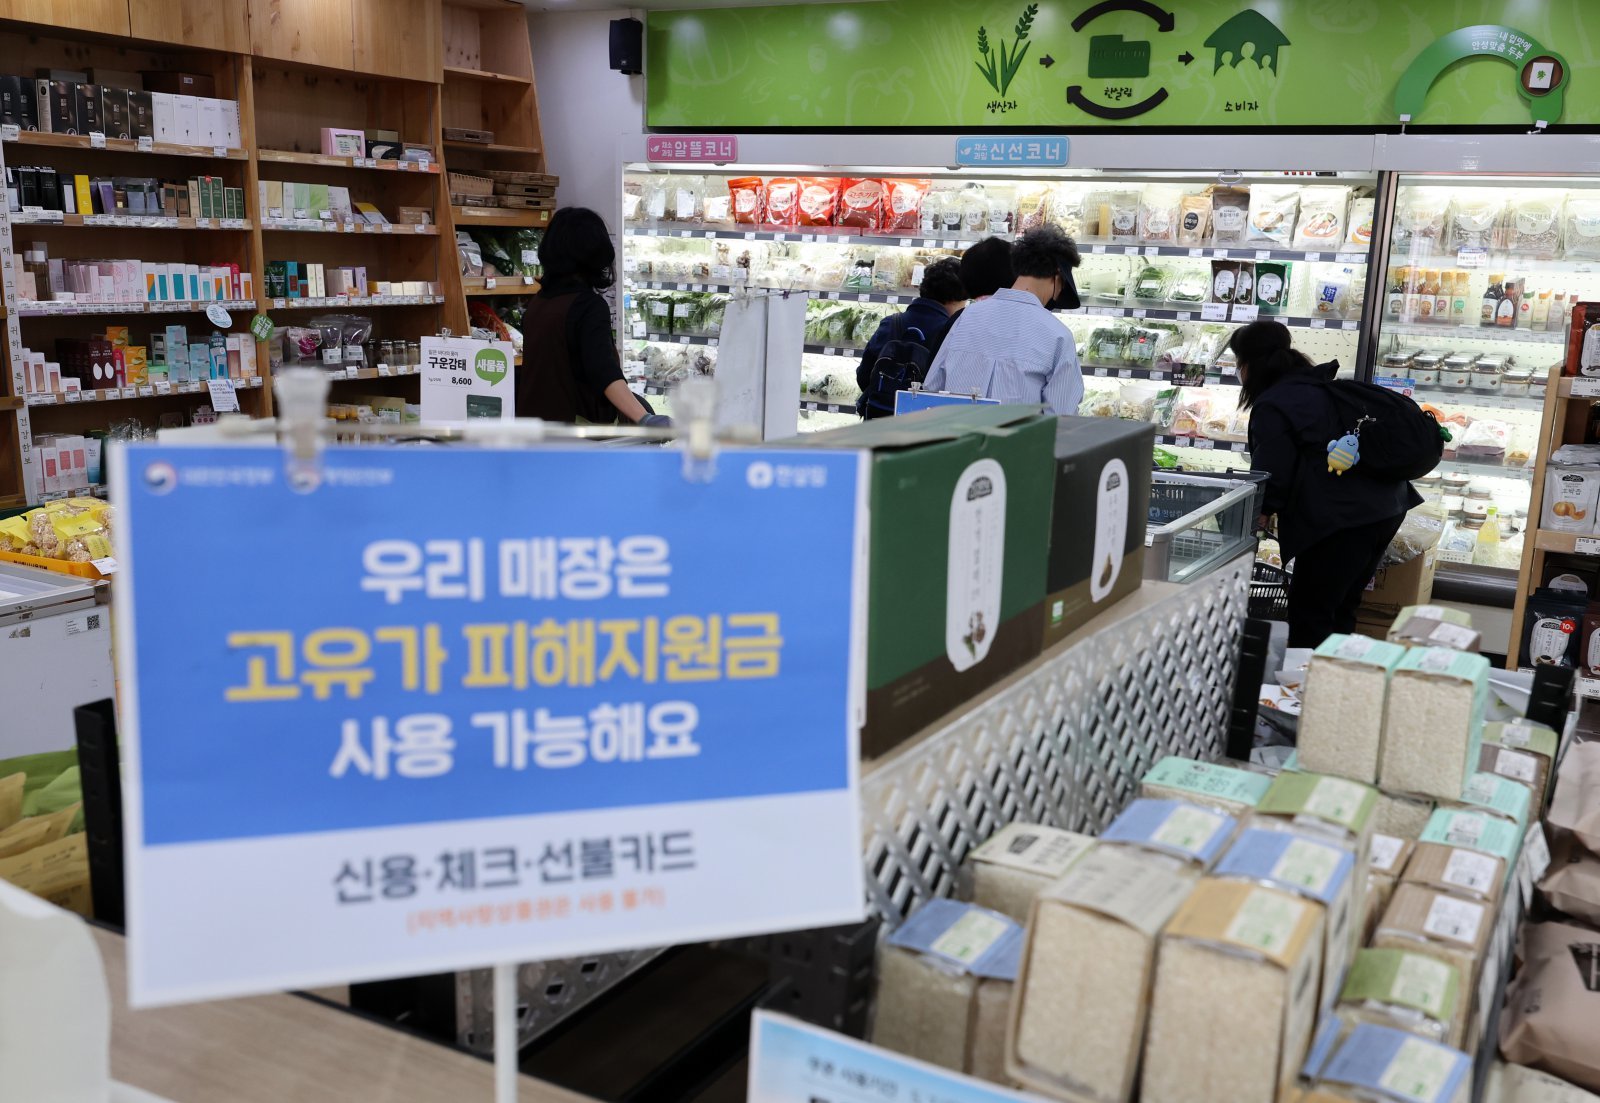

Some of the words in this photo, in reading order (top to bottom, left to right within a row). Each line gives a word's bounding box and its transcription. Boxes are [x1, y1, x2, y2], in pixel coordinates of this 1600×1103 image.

[1471, 41, 1506, 52] 안성맞춤
[1508, 46, 1525, 60] 두부
[1499, 32, 1509, 41] 내
[1509, 34, 1533, 52] 입맛에
[1103, 86, 1133, 101] 한살림
[986, 101, 1018, 113] 생산자
[1224, 101, 1259, 113] 소비자
[674, 141, 732, 158] 알뜰코너
[990, 143, 1060, 160] 신선코너
[427, 356, 467, 371] 구운감태
[477, 358, 506, 373] 새물품
[451, 377, 472, 386] 8,600
[359, 538, 485, 603] 우리
[498, 535, 673, 602] 매장은
[223, 622, 450, 703] 고유가
[461, 612, 785, 690] 피해지원금
[328, 713, 457, 780] 사용
[471, 701, 703, 770] 가능해요
[332, 831, 697, 905] 신용·체크·선불카드
